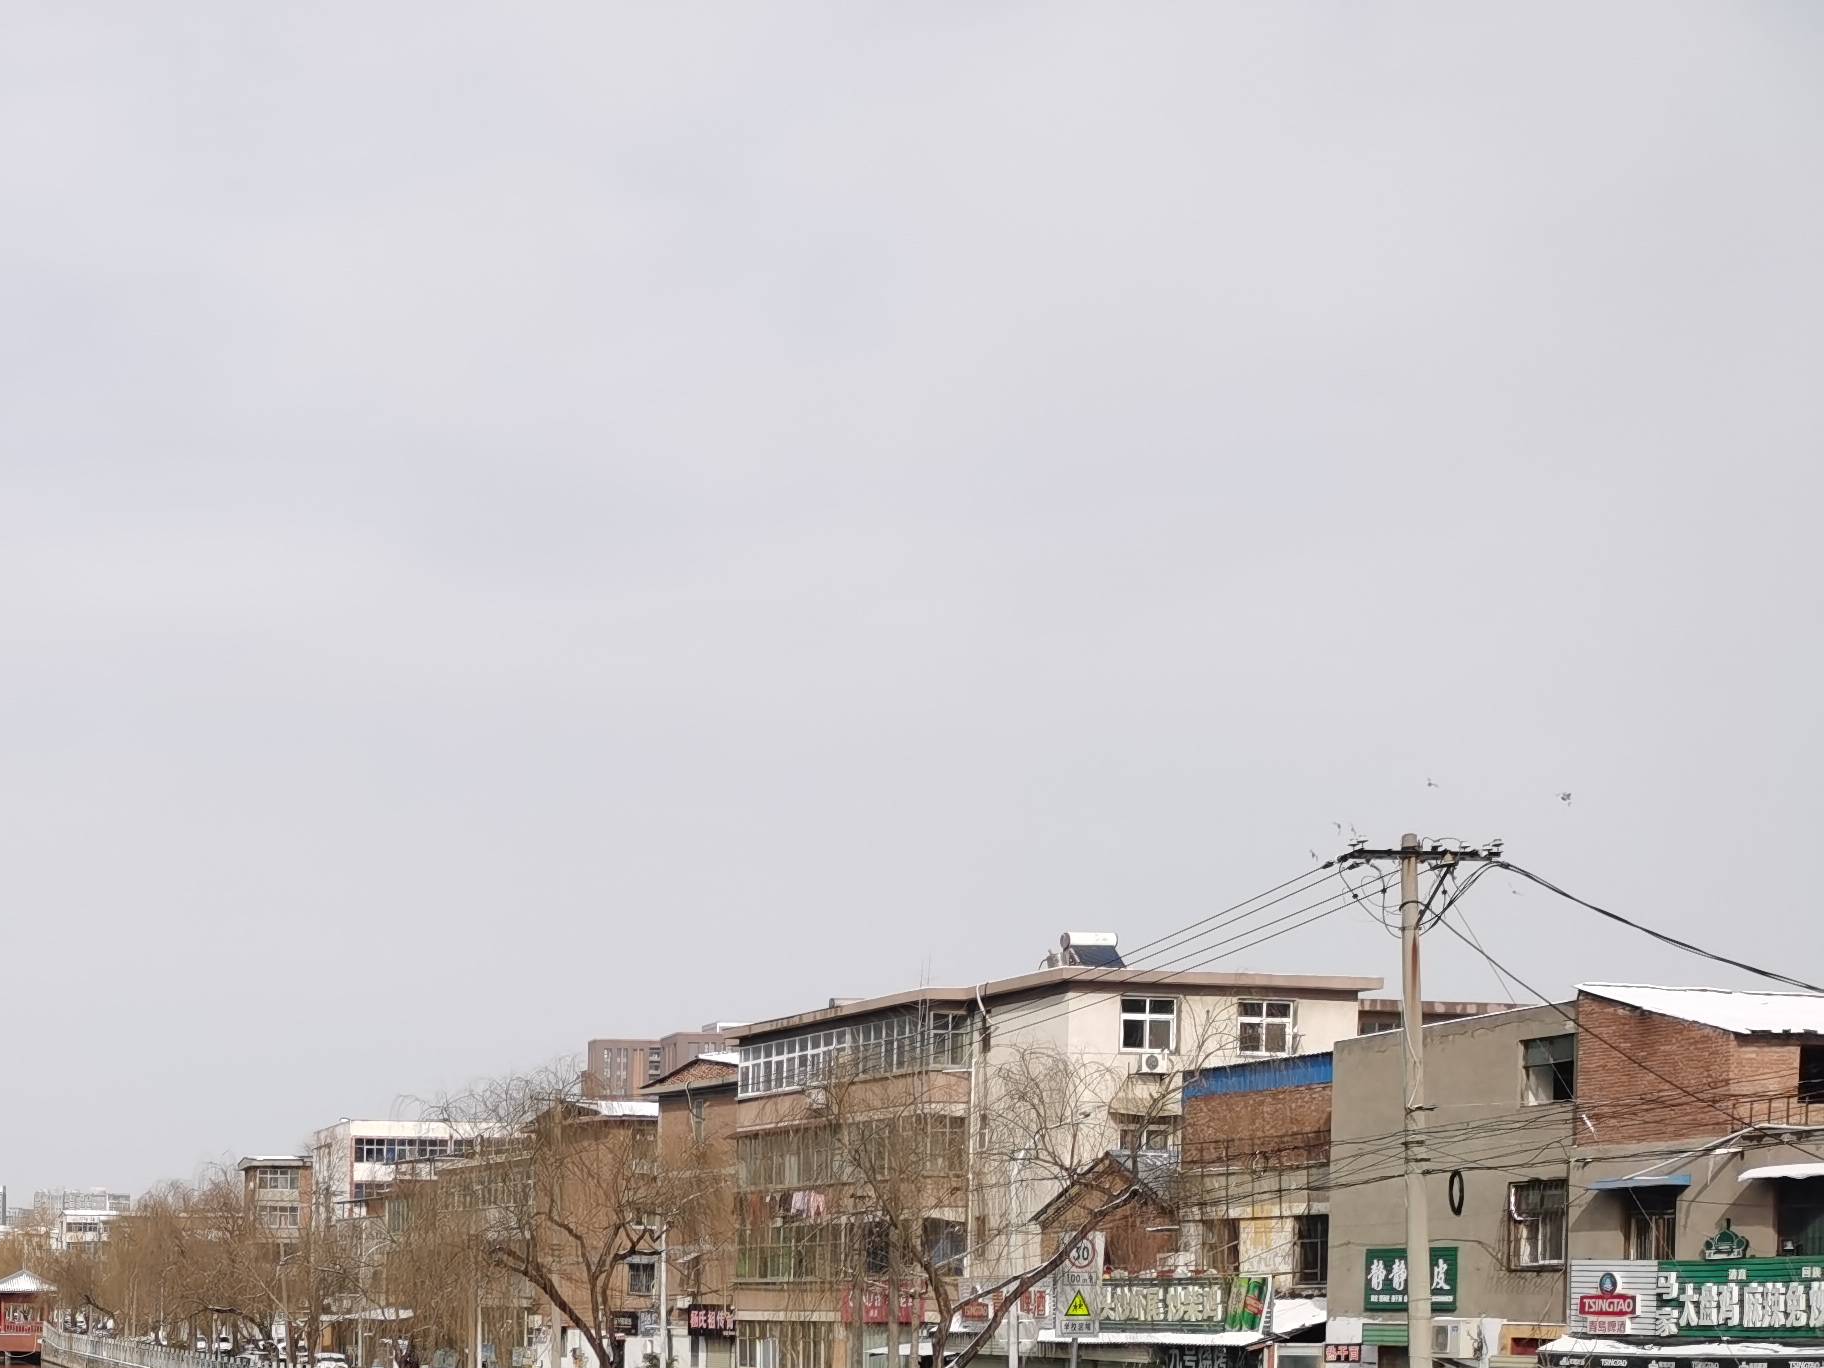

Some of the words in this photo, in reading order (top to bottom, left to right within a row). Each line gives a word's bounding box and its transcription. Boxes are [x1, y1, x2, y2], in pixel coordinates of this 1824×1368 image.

[1368, 1259, 1451, 1290] 静静皮
[1584, 1298, 1633, 1313] TSINGTAO
[1588, 1320, 1626, 1333] 青岛啤酒
